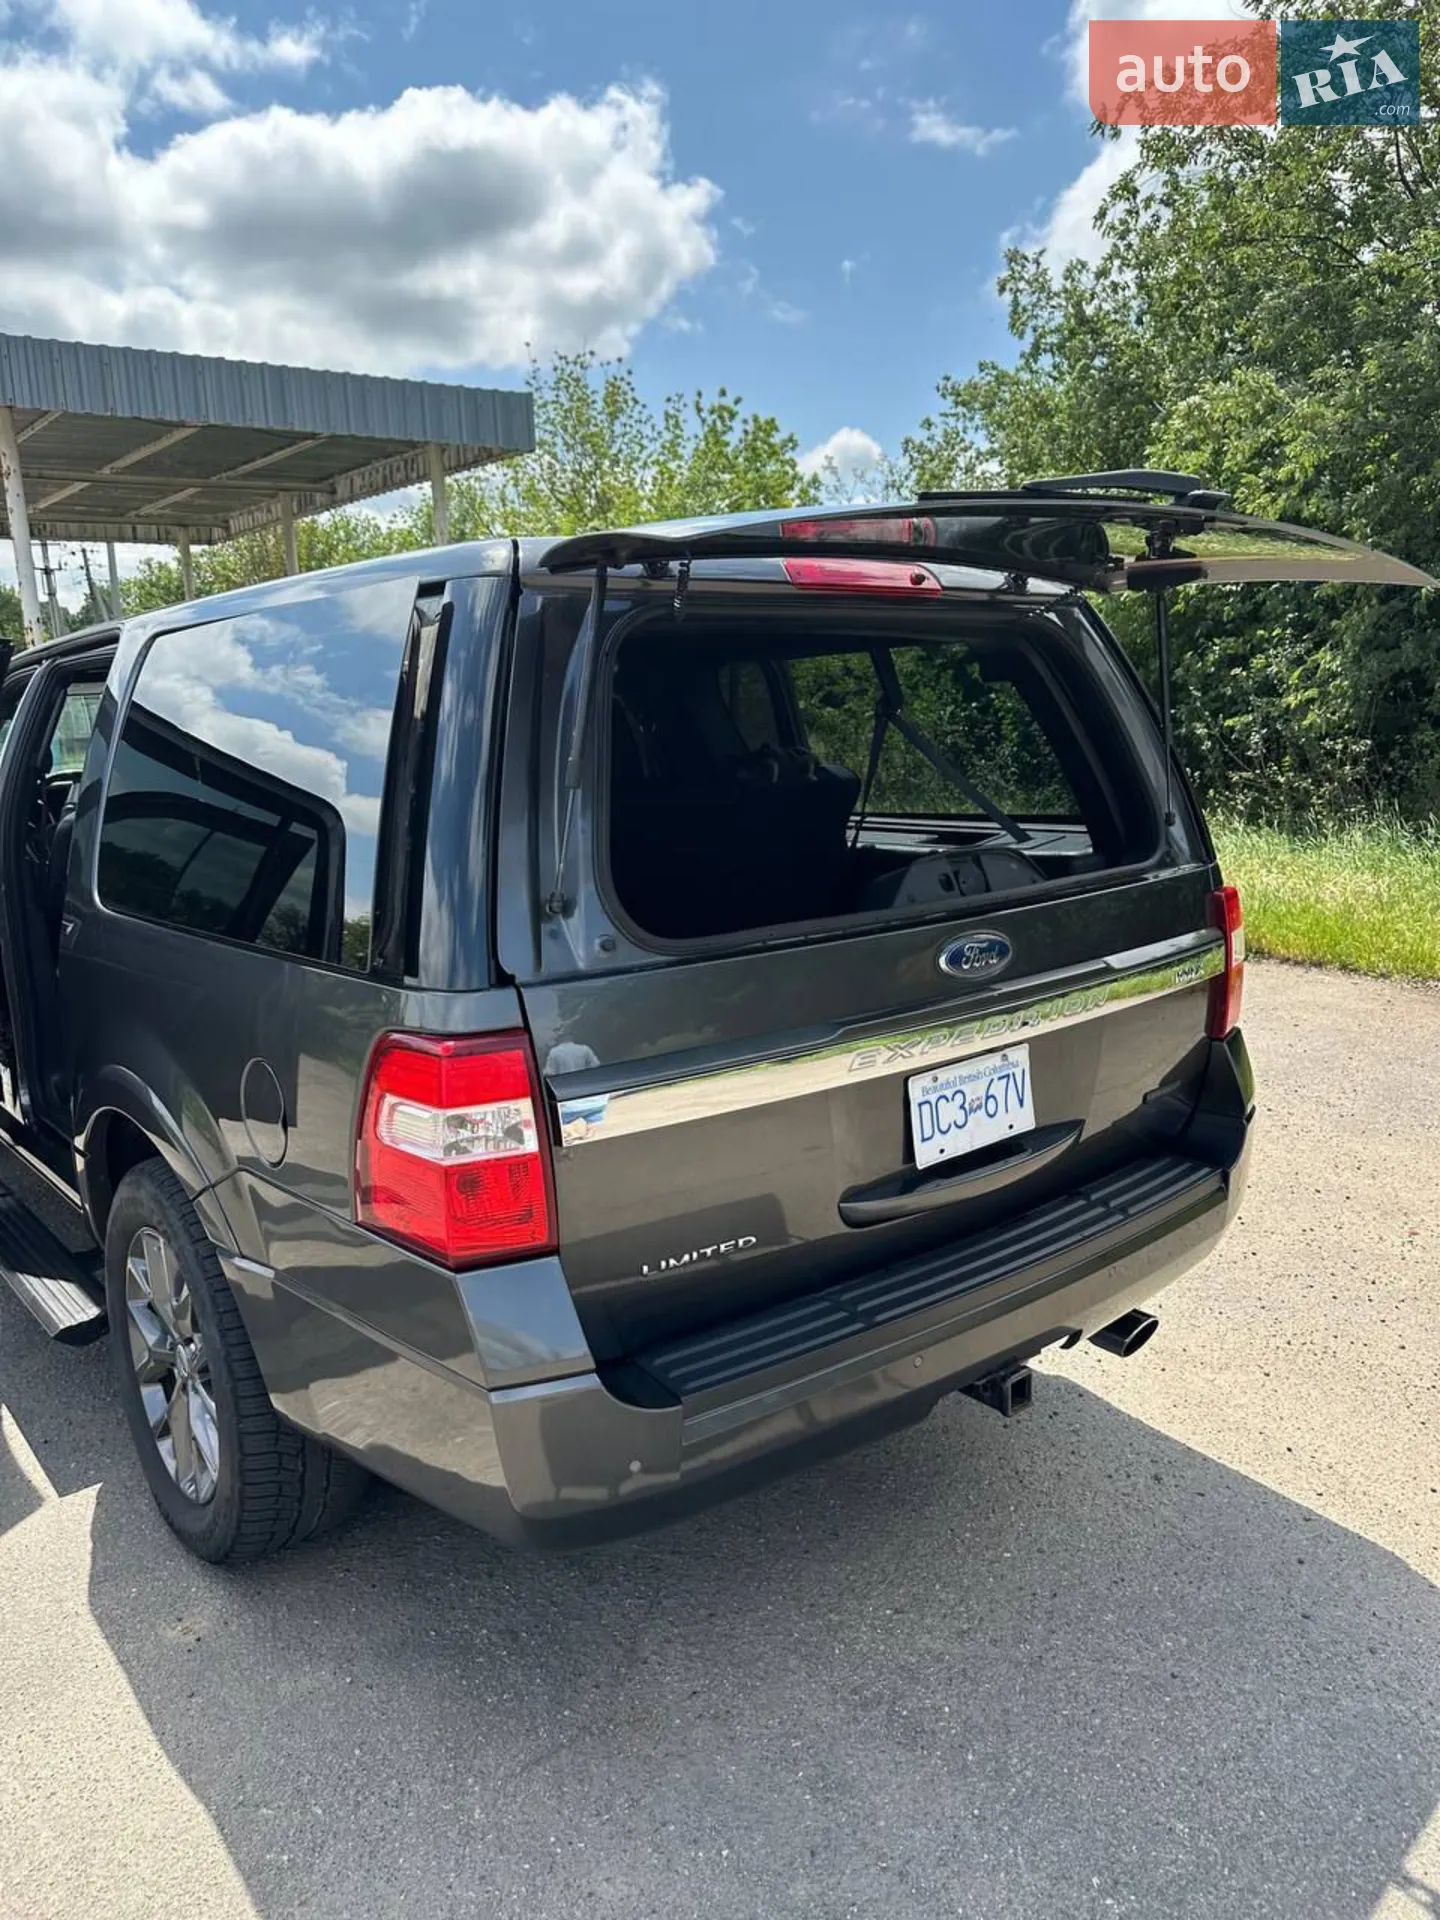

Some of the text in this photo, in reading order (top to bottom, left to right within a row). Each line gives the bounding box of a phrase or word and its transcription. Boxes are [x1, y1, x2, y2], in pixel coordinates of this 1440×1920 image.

[961, 941, 1000, 969] Ford
[848, 986, 1110, 1072] EXPEDITION
[921, 1060, 1020, 1096] Beautiful British Columbia
[917, 1068, 1025, 1143] DC3 67V
[641, 1236, 757, 1277] LIMITED
